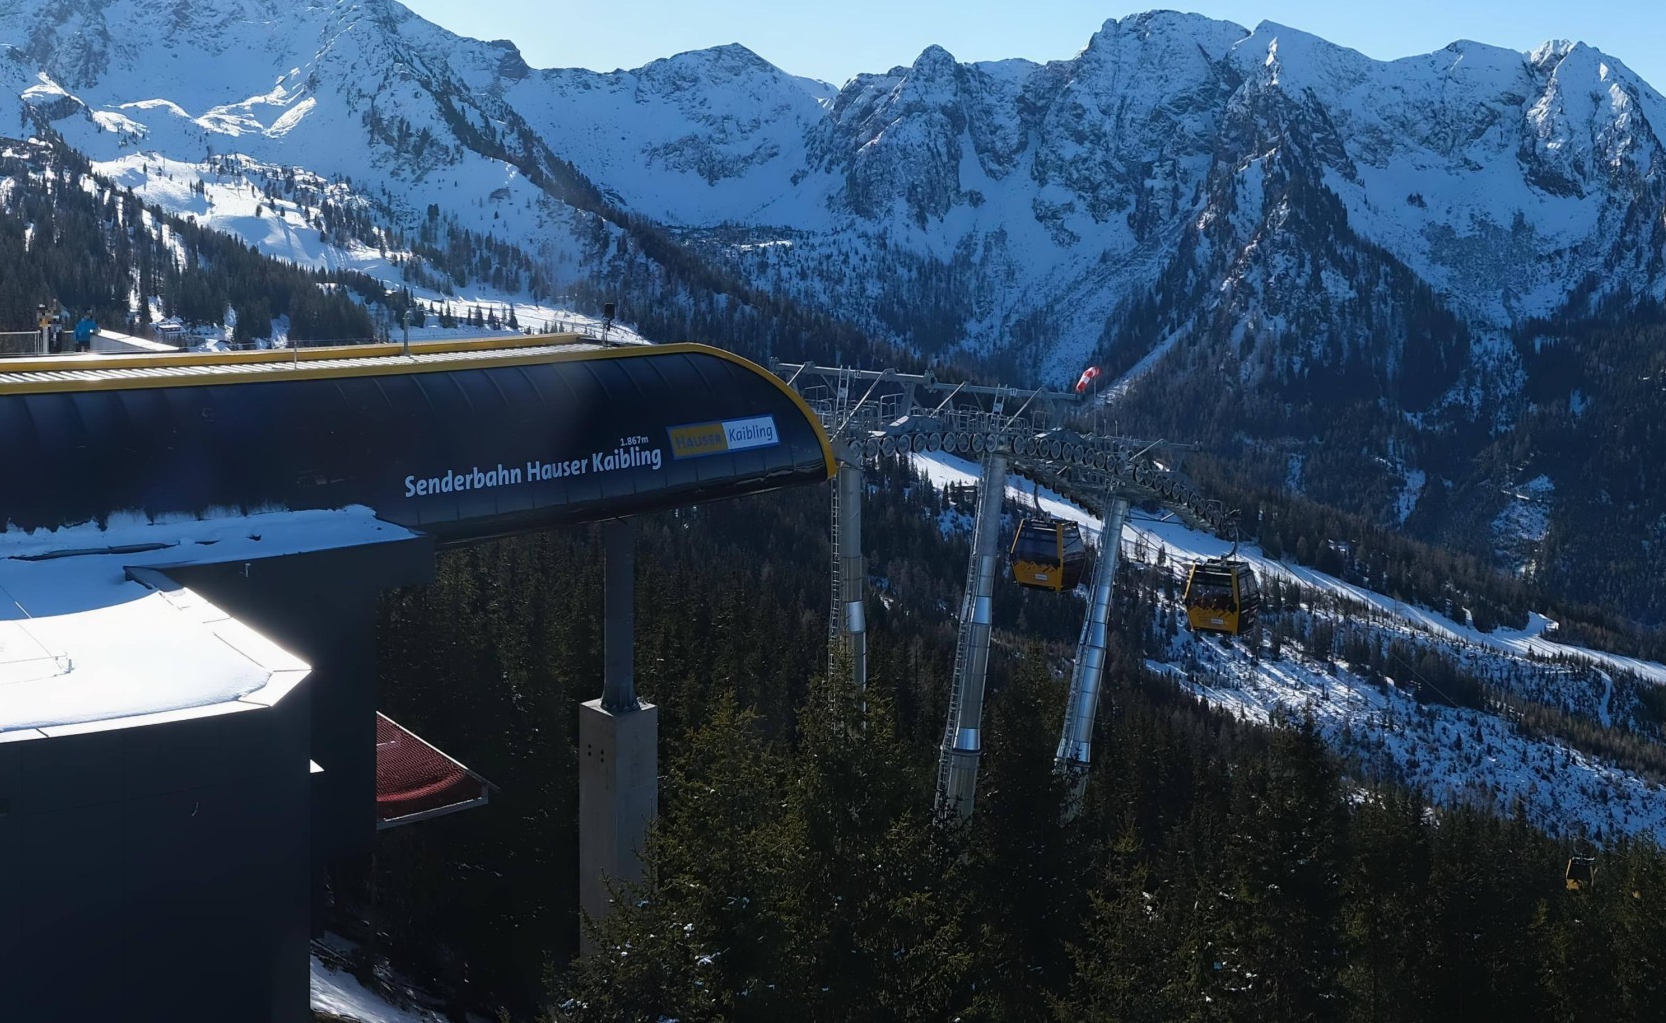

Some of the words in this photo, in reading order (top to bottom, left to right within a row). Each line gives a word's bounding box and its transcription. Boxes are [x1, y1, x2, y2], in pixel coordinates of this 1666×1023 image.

[675, 432, 723, 451] HAUSER
[729, 424, 773, 445] Kaibling
[405, 464, 522, 498] Senderbahn
[527, 456, 589, 483] Hauser
[591, 447, 662, 473] Kaibling
